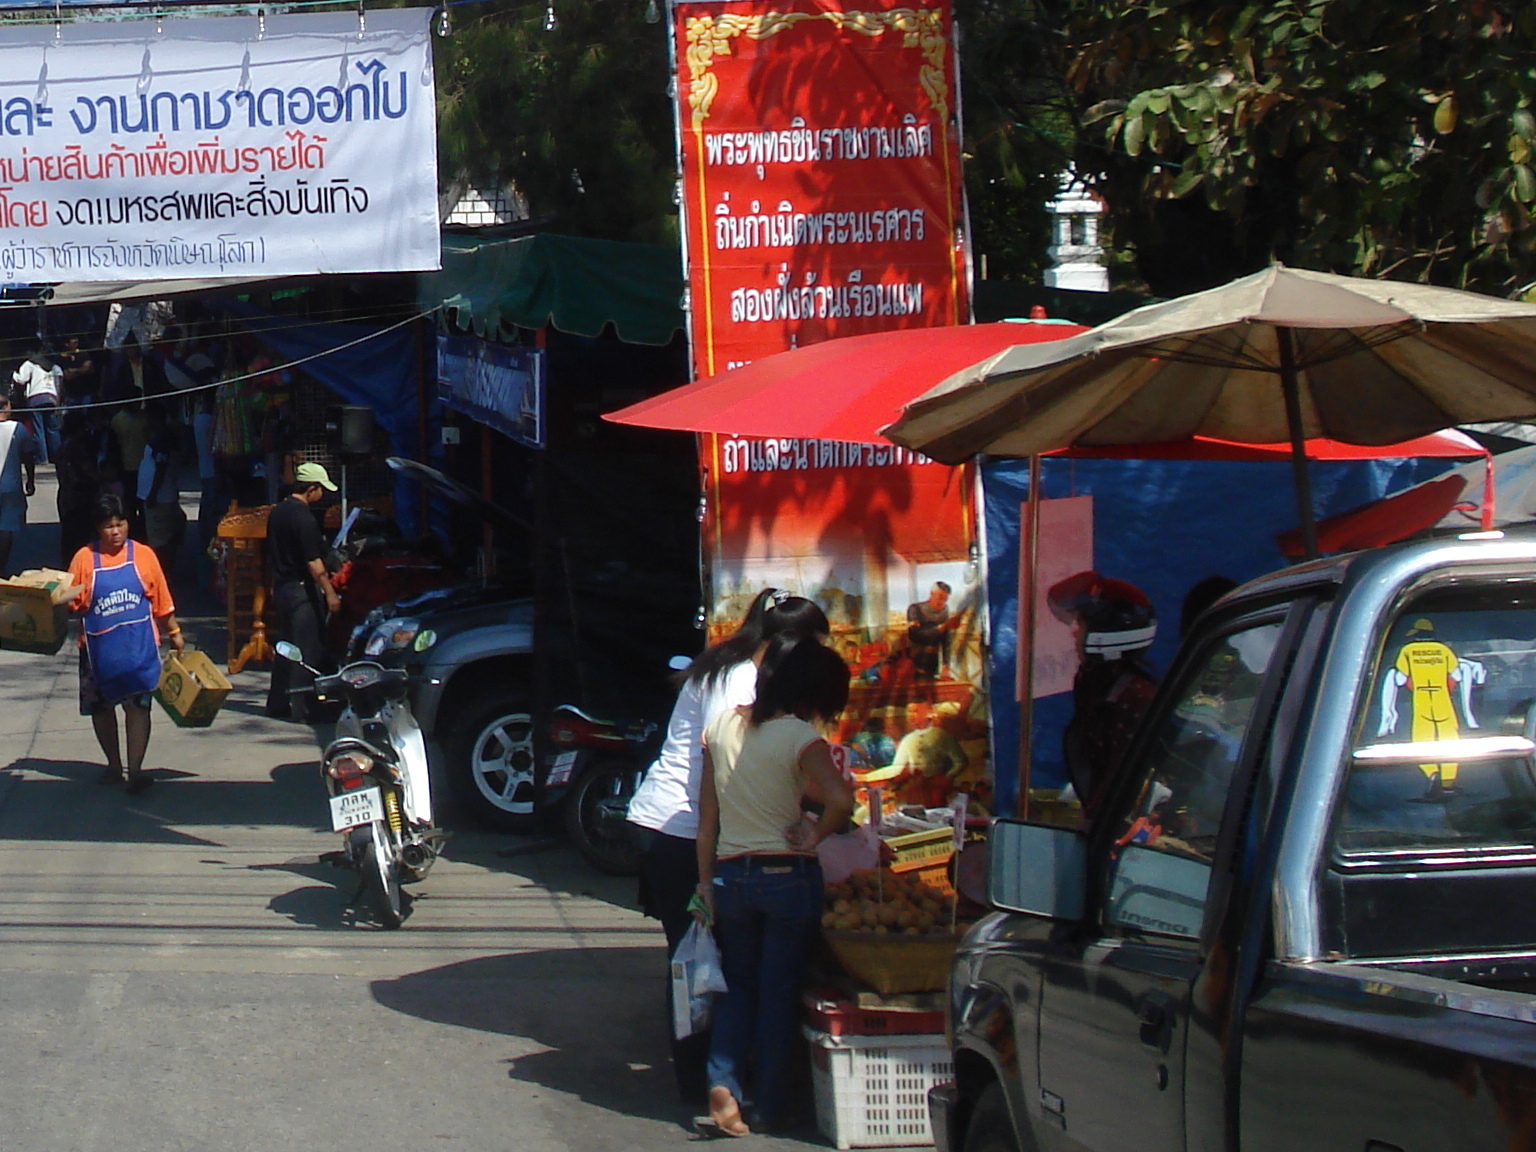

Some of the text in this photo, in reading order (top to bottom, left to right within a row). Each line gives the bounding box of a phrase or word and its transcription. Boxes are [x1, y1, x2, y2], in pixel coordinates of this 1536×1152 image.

[69, 59, 407, 135] งานกาชาดออกไป
[706, 113, 932, 181] พระพุทธชินราชงามเลิศ
[55, 175, 369, 226] งด!มหรสพและสิ่งบันเทิง
[715, 191, 925, 249] ถิ่นกำเนิดพระนเรศวร
[731, 262, 923, 323] สองฝั่งล้วนเรือนแพ
[344, 811, 371, 825] 310
